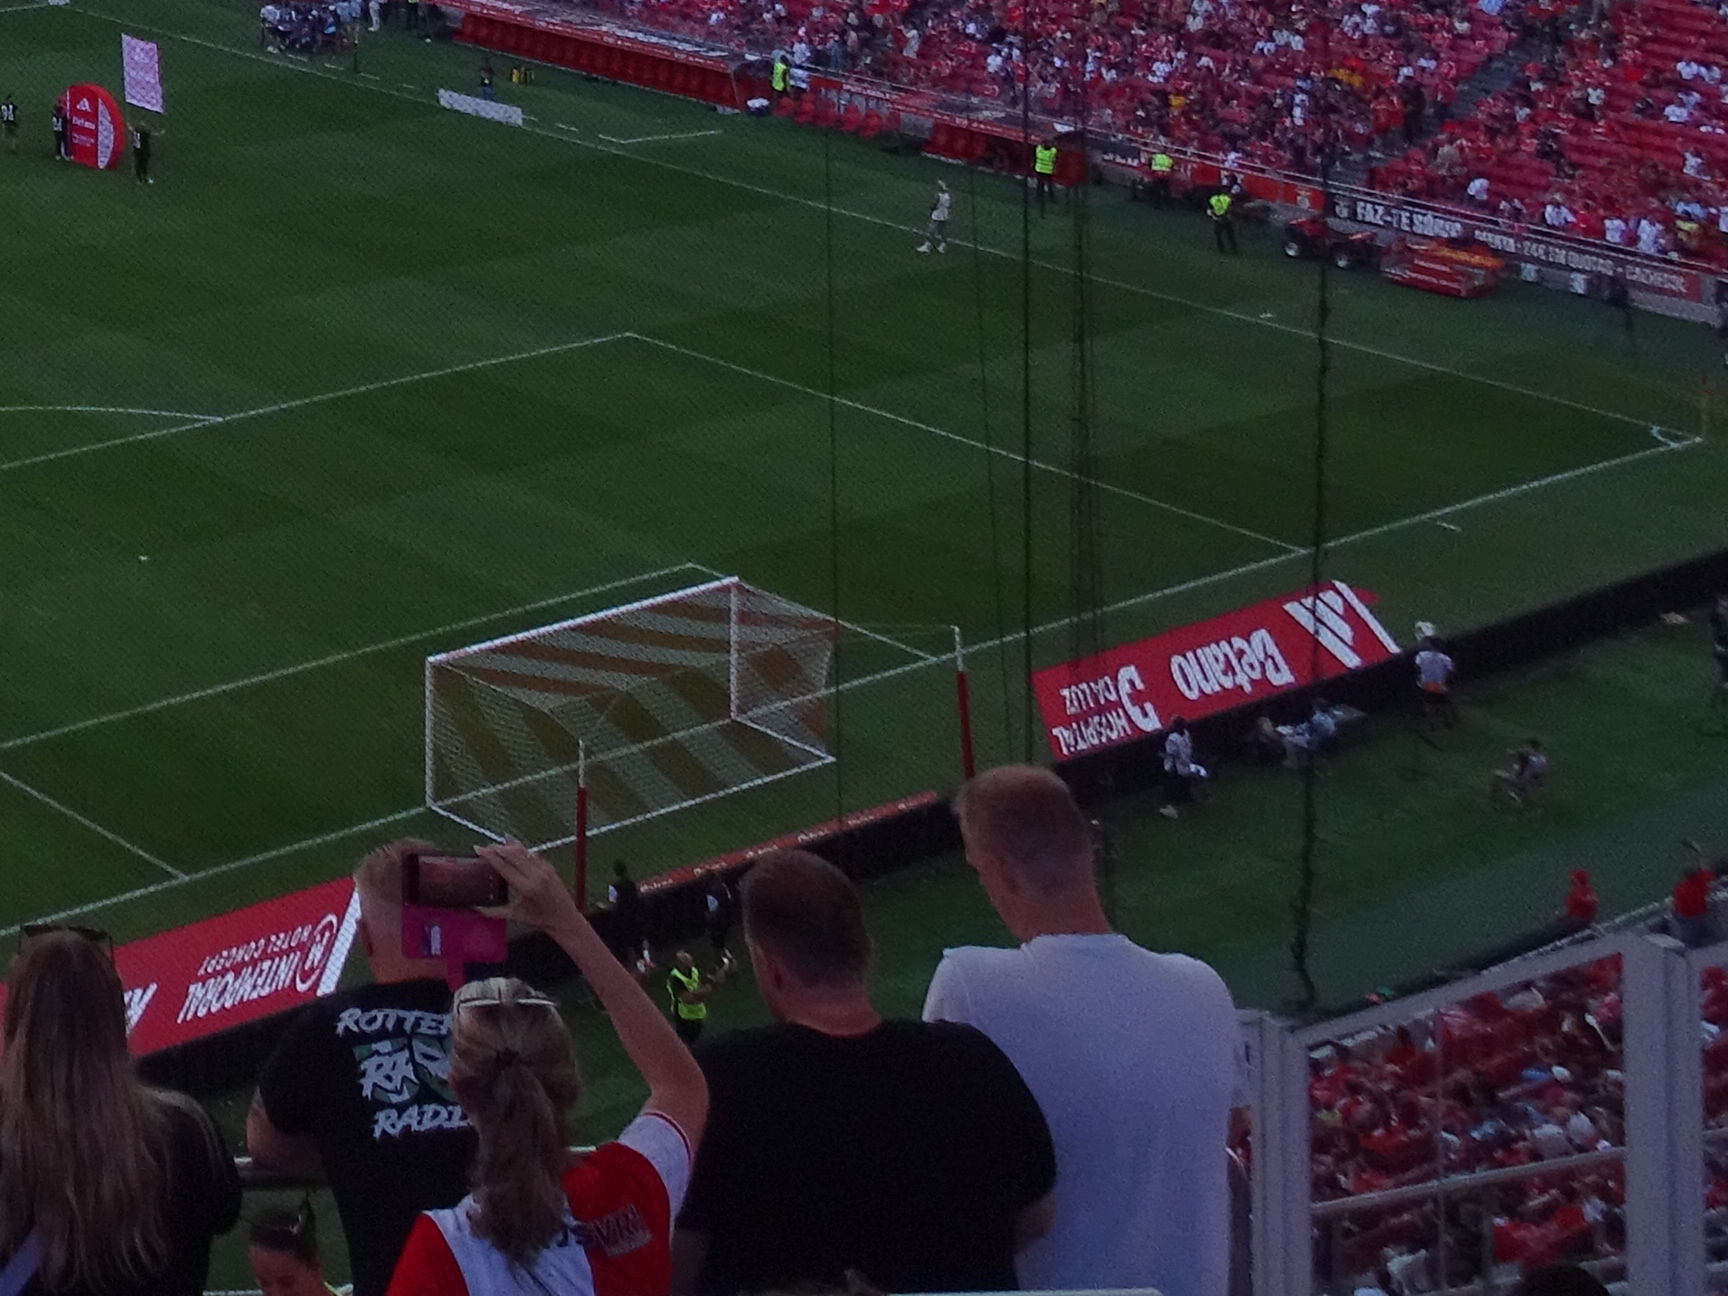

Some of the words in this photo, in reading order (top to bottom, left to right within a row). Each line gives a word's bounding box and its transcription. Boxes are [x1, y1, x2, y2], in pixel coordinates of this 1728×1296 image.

[1170, 628, 1295, 700] Betano
[1060, 681, 1092, 716] LUZ
[1090, 675, 1120, 706] DA
[1052, 707, 1132, 756] HOSPITAL
[267, 924, 312, 954] HOTEL
[177, 951, 302, 1024] INTEMPORAL
